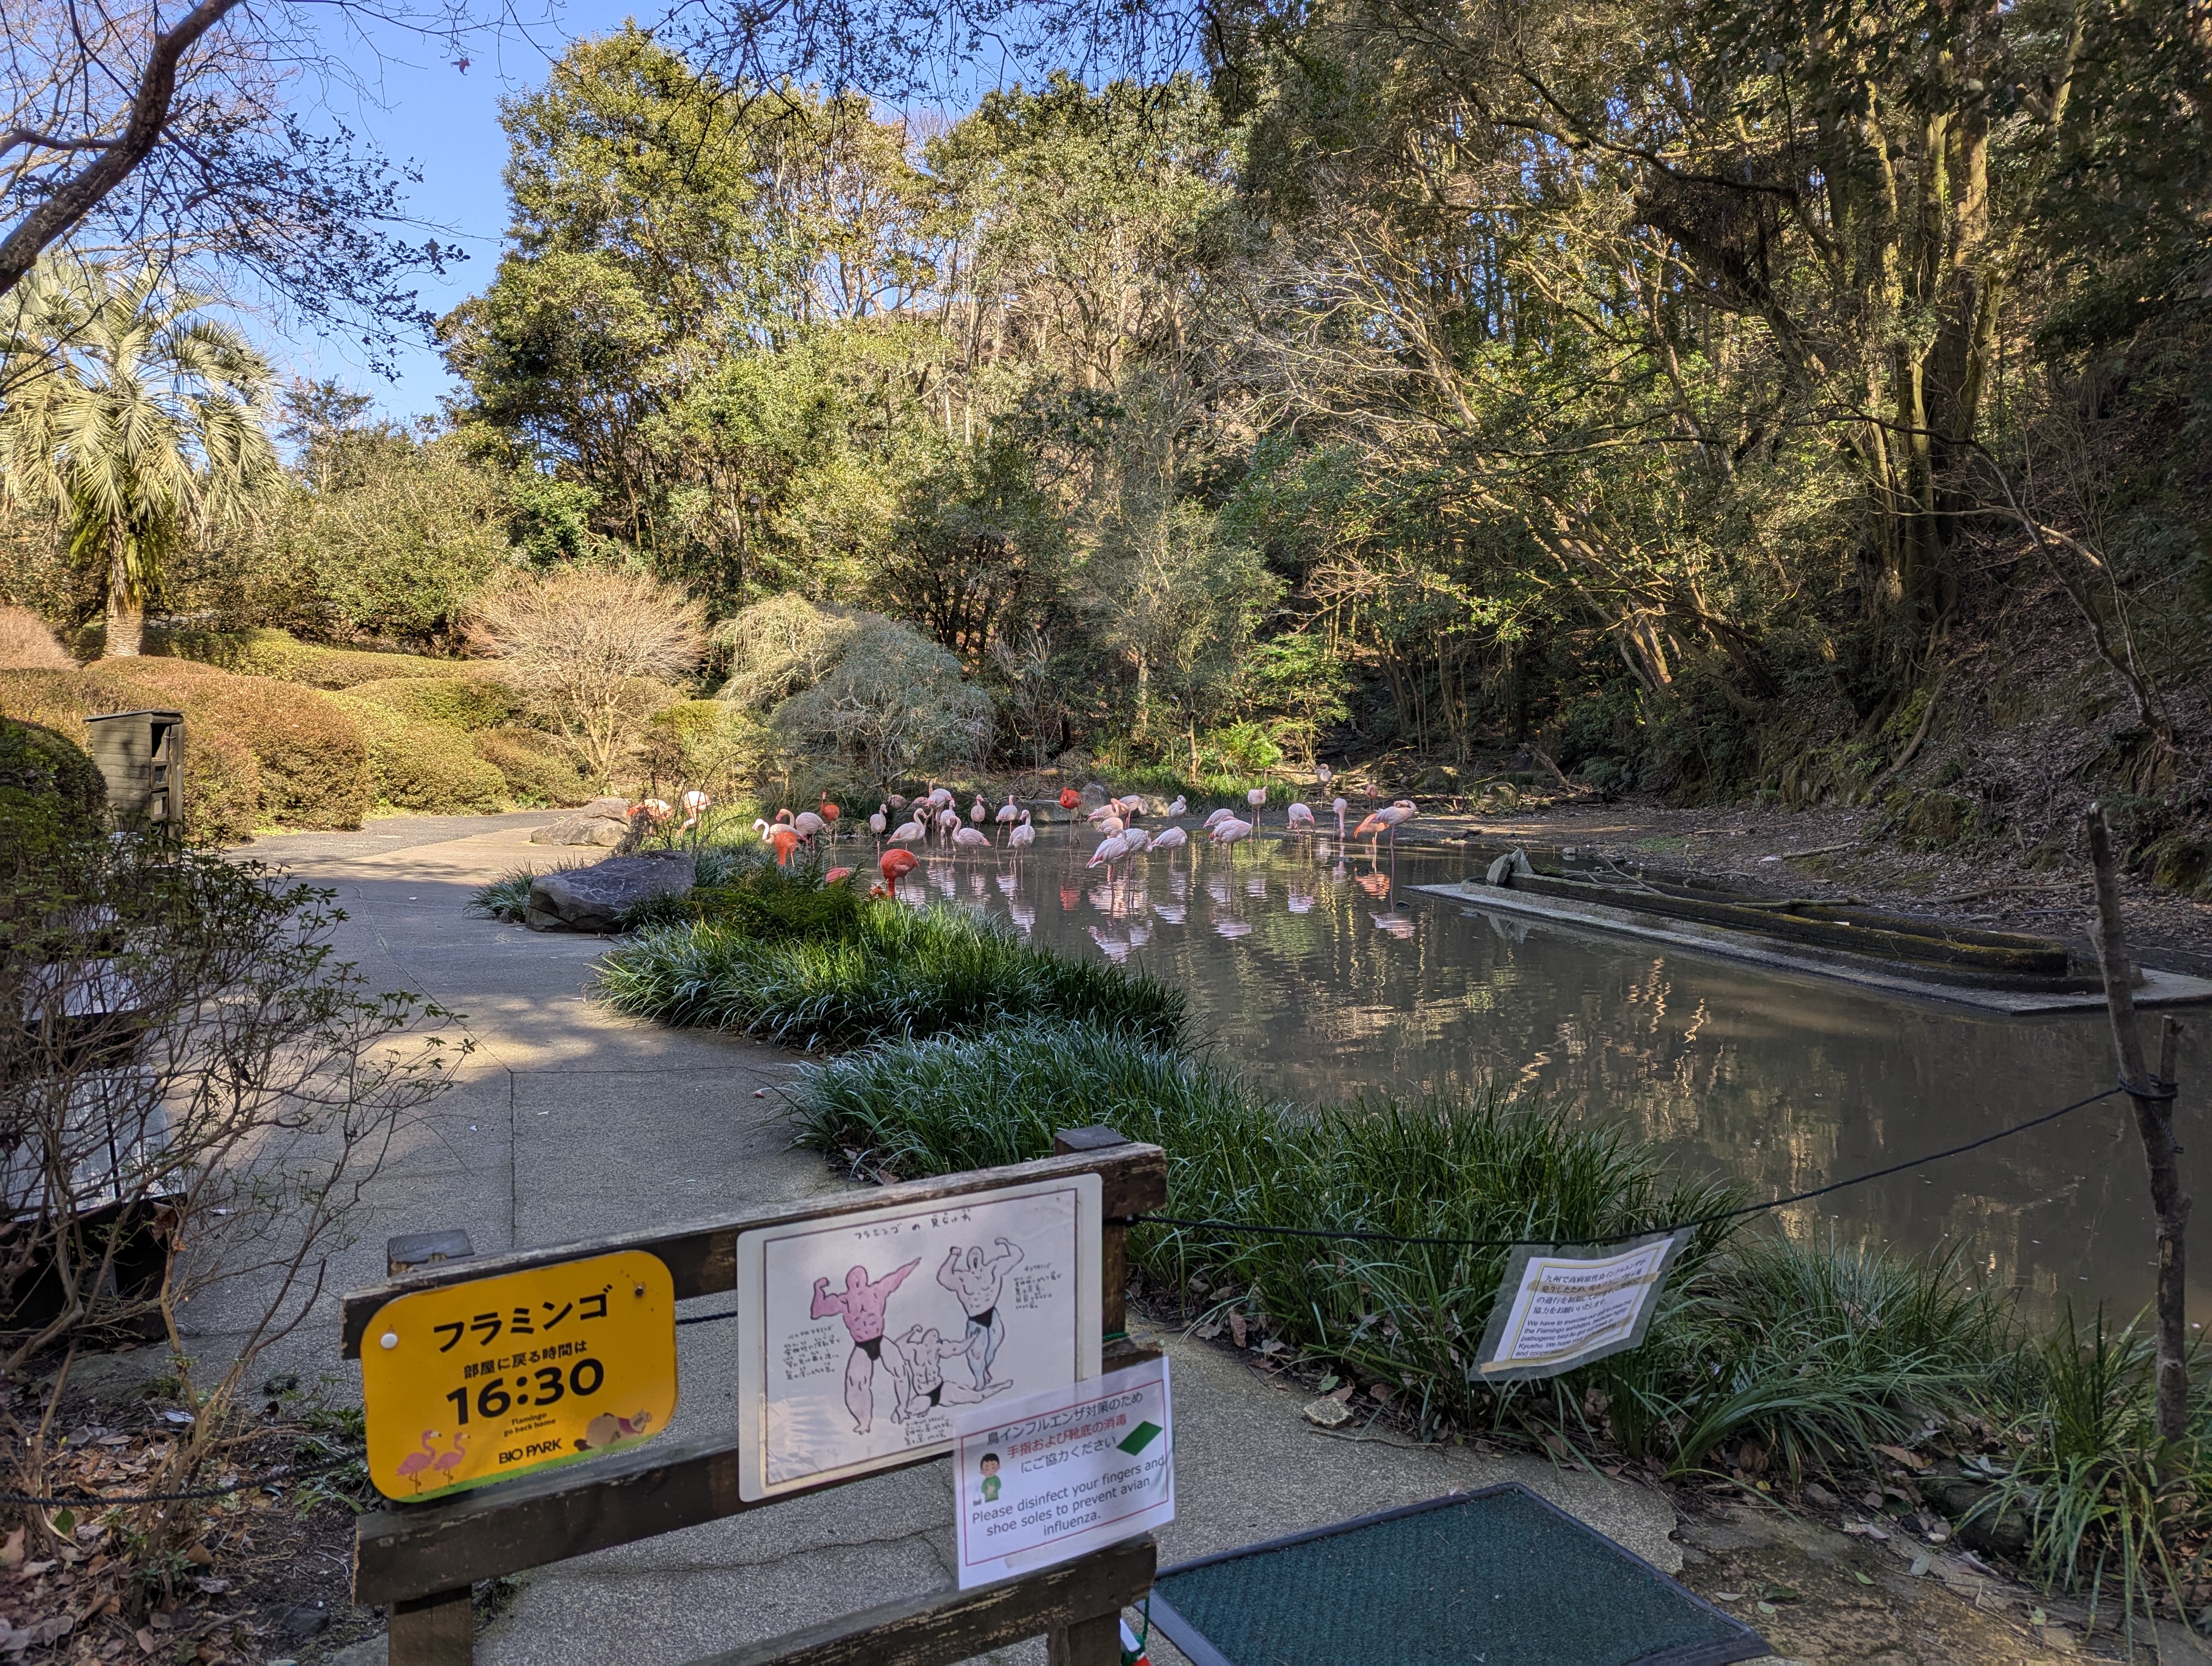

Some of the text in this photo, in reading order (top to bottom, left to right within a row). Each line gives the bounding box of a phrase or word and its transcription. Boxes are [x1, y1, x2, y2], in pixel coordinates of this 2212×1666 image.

[434, 1284, 613, 1353] フラミンゴ
[464, 1340, 588, 1379] 部屋に戻る時間は
[446, 1358, 604, 1426] 16:30
[504, 1419, 556, 1438] go back home
[512, 1413, 547, 1425] Flamingo
[987, 1392, 1143, 1446] 鳥インフルエンザ対策のため
[1007, 1414, 1128, 1459] 手指および靴底の消毒
[499, 1438, 562, 1464] BIO PARK
[1021, 1437, 1117, 1473] にご協力ください
[972, 1456, 1165, 1524] Please disinfect your fingers and
[986, 1477, 1150, 1536] shoe soles to prevent avian
[1043, 1511, 1101, 1536] influenza.
